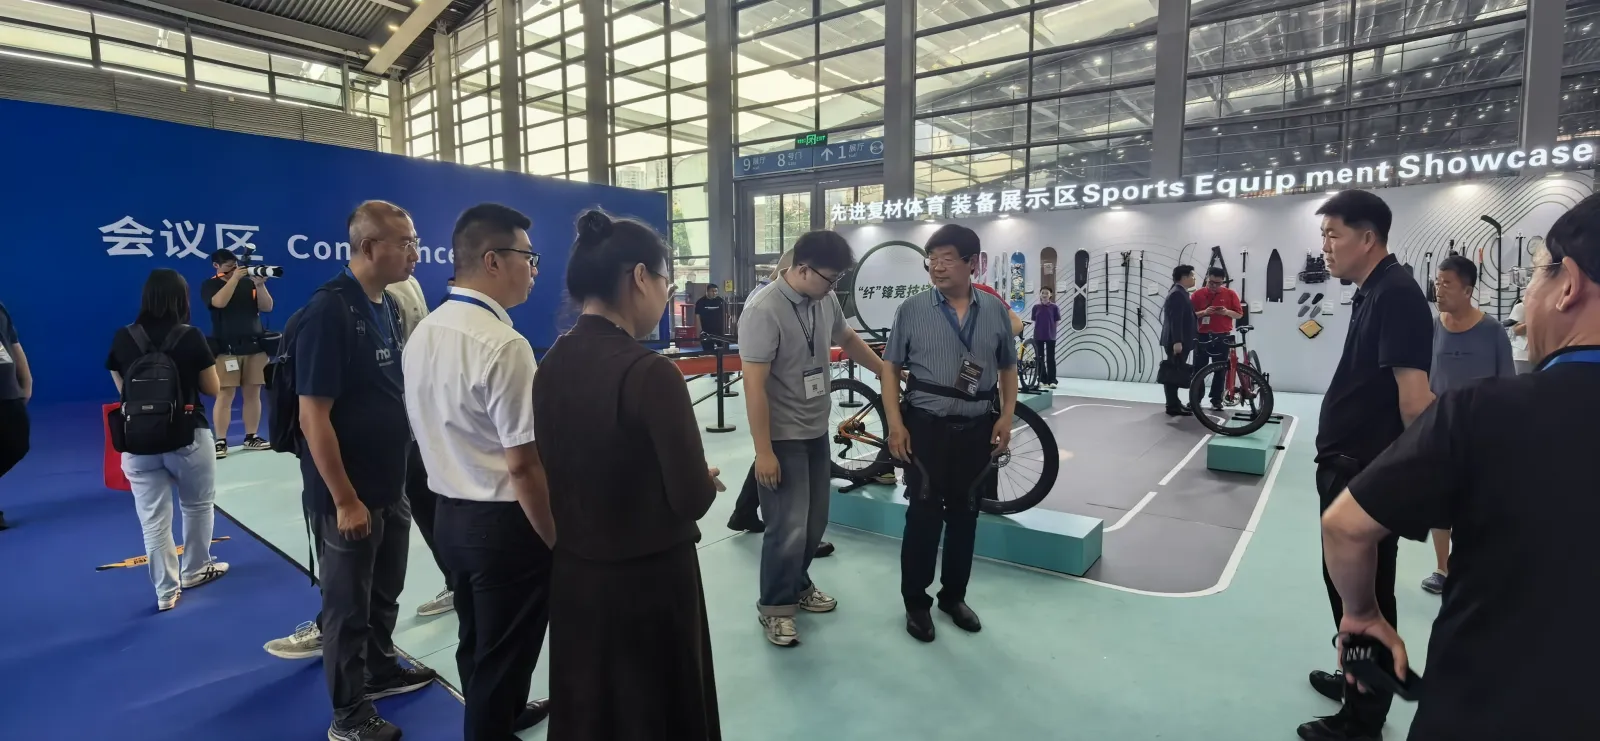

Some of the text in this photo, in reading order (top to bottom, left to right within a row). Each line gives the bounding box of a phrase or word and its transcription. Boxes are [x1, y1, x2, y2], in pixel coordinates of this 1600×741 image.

[777, 153, 786, 167] 8
[838, 145, 847, 160] 1
[743, 158, 751, 171] 9
[1082, 180, 1185, 207] Sports
[1398, 142, 1594, 178] Showcase
[98, 214, 264, 261] 会议区
[287, 234, 454, 264] Connc
